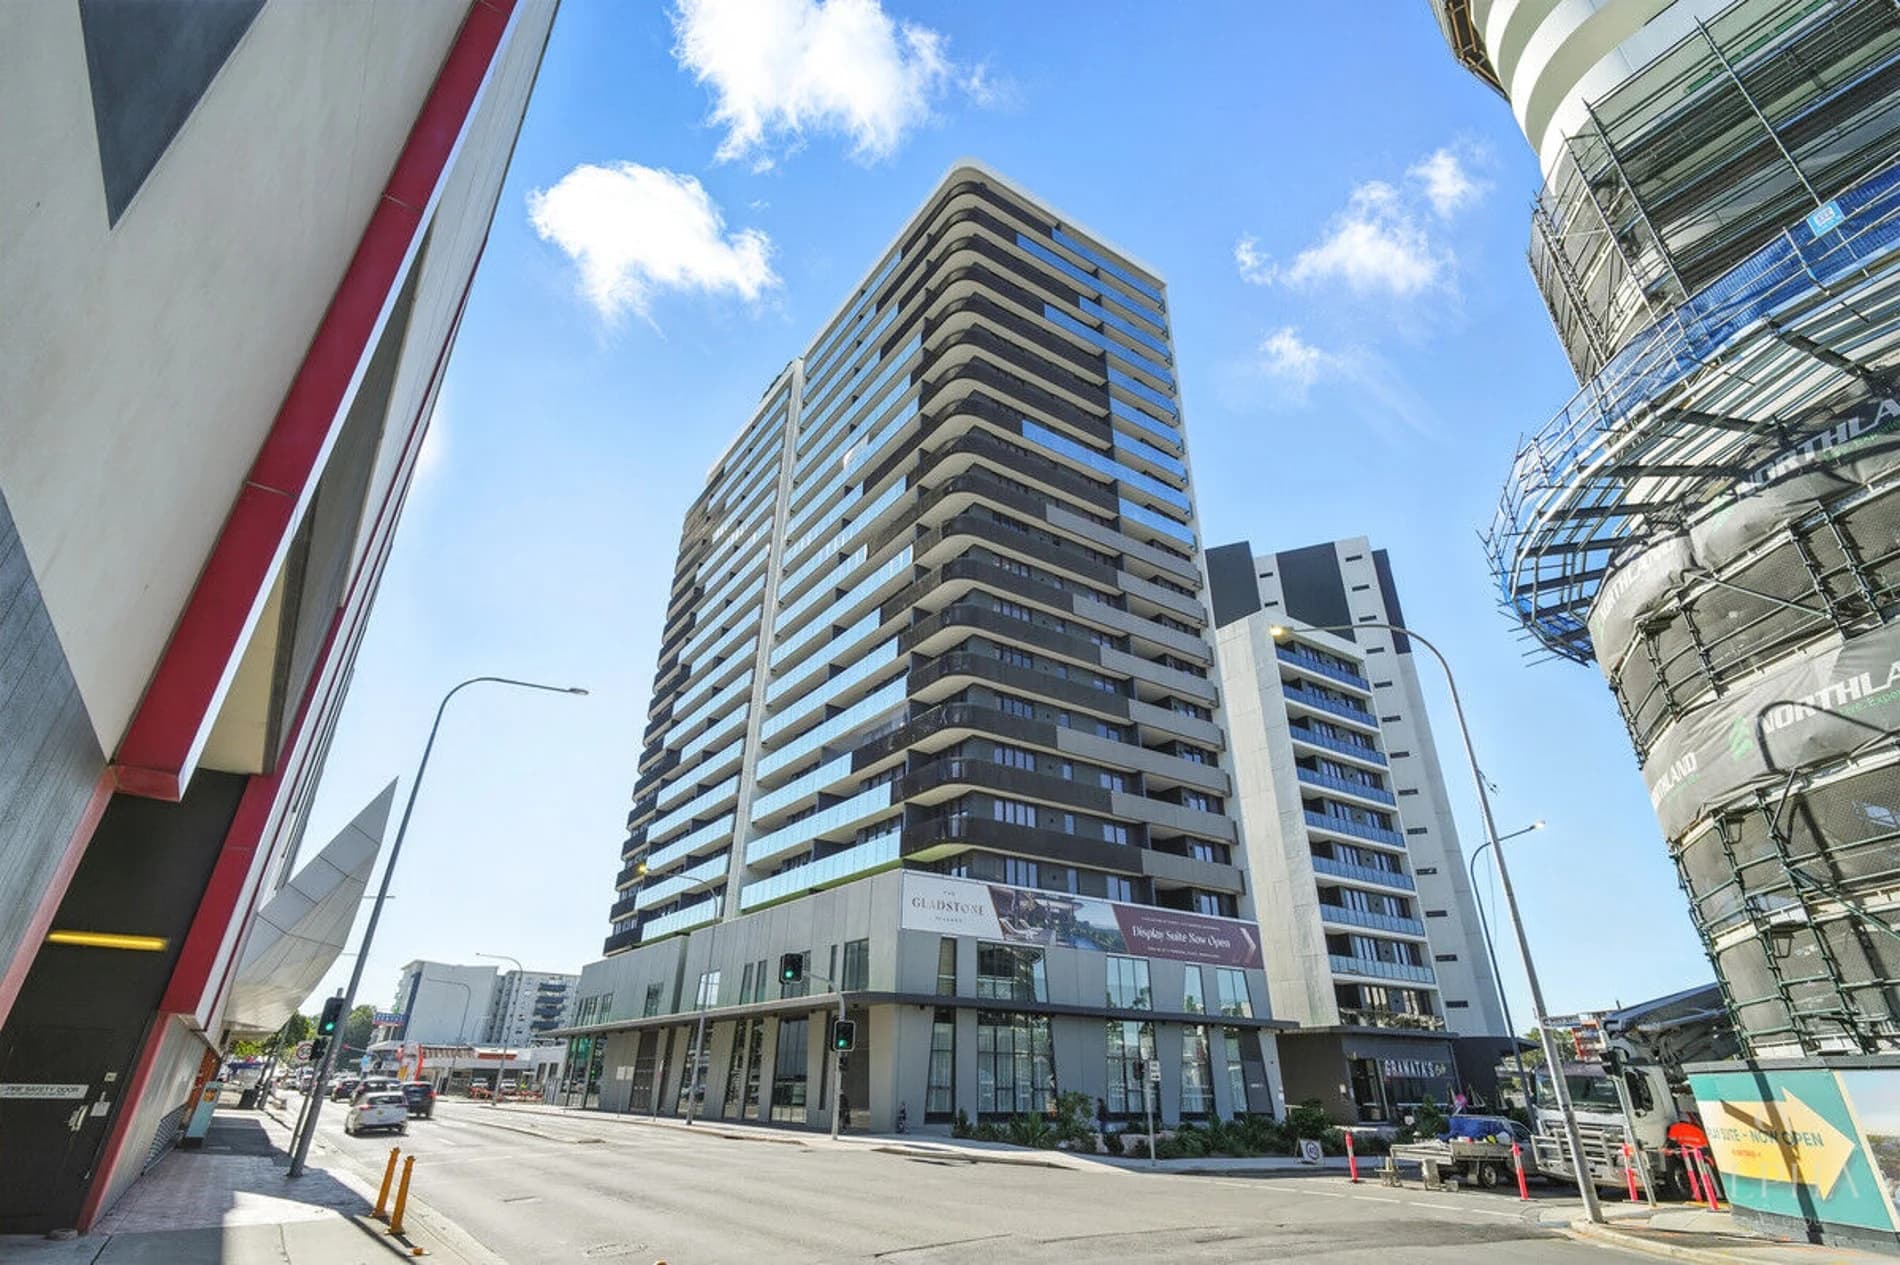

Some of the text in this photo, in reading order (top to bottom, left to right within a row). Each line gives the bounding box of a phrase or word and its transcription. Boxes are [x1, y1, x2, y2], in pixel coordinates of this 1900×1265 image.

[911, 896, 984, 915] GLADSTONE
[1132, 925, 1231, 949] Display Suite Now Open
[1749, 1128, 1778, 1143] NOW
[1780, 1130, 1825, 1147] OPEN
